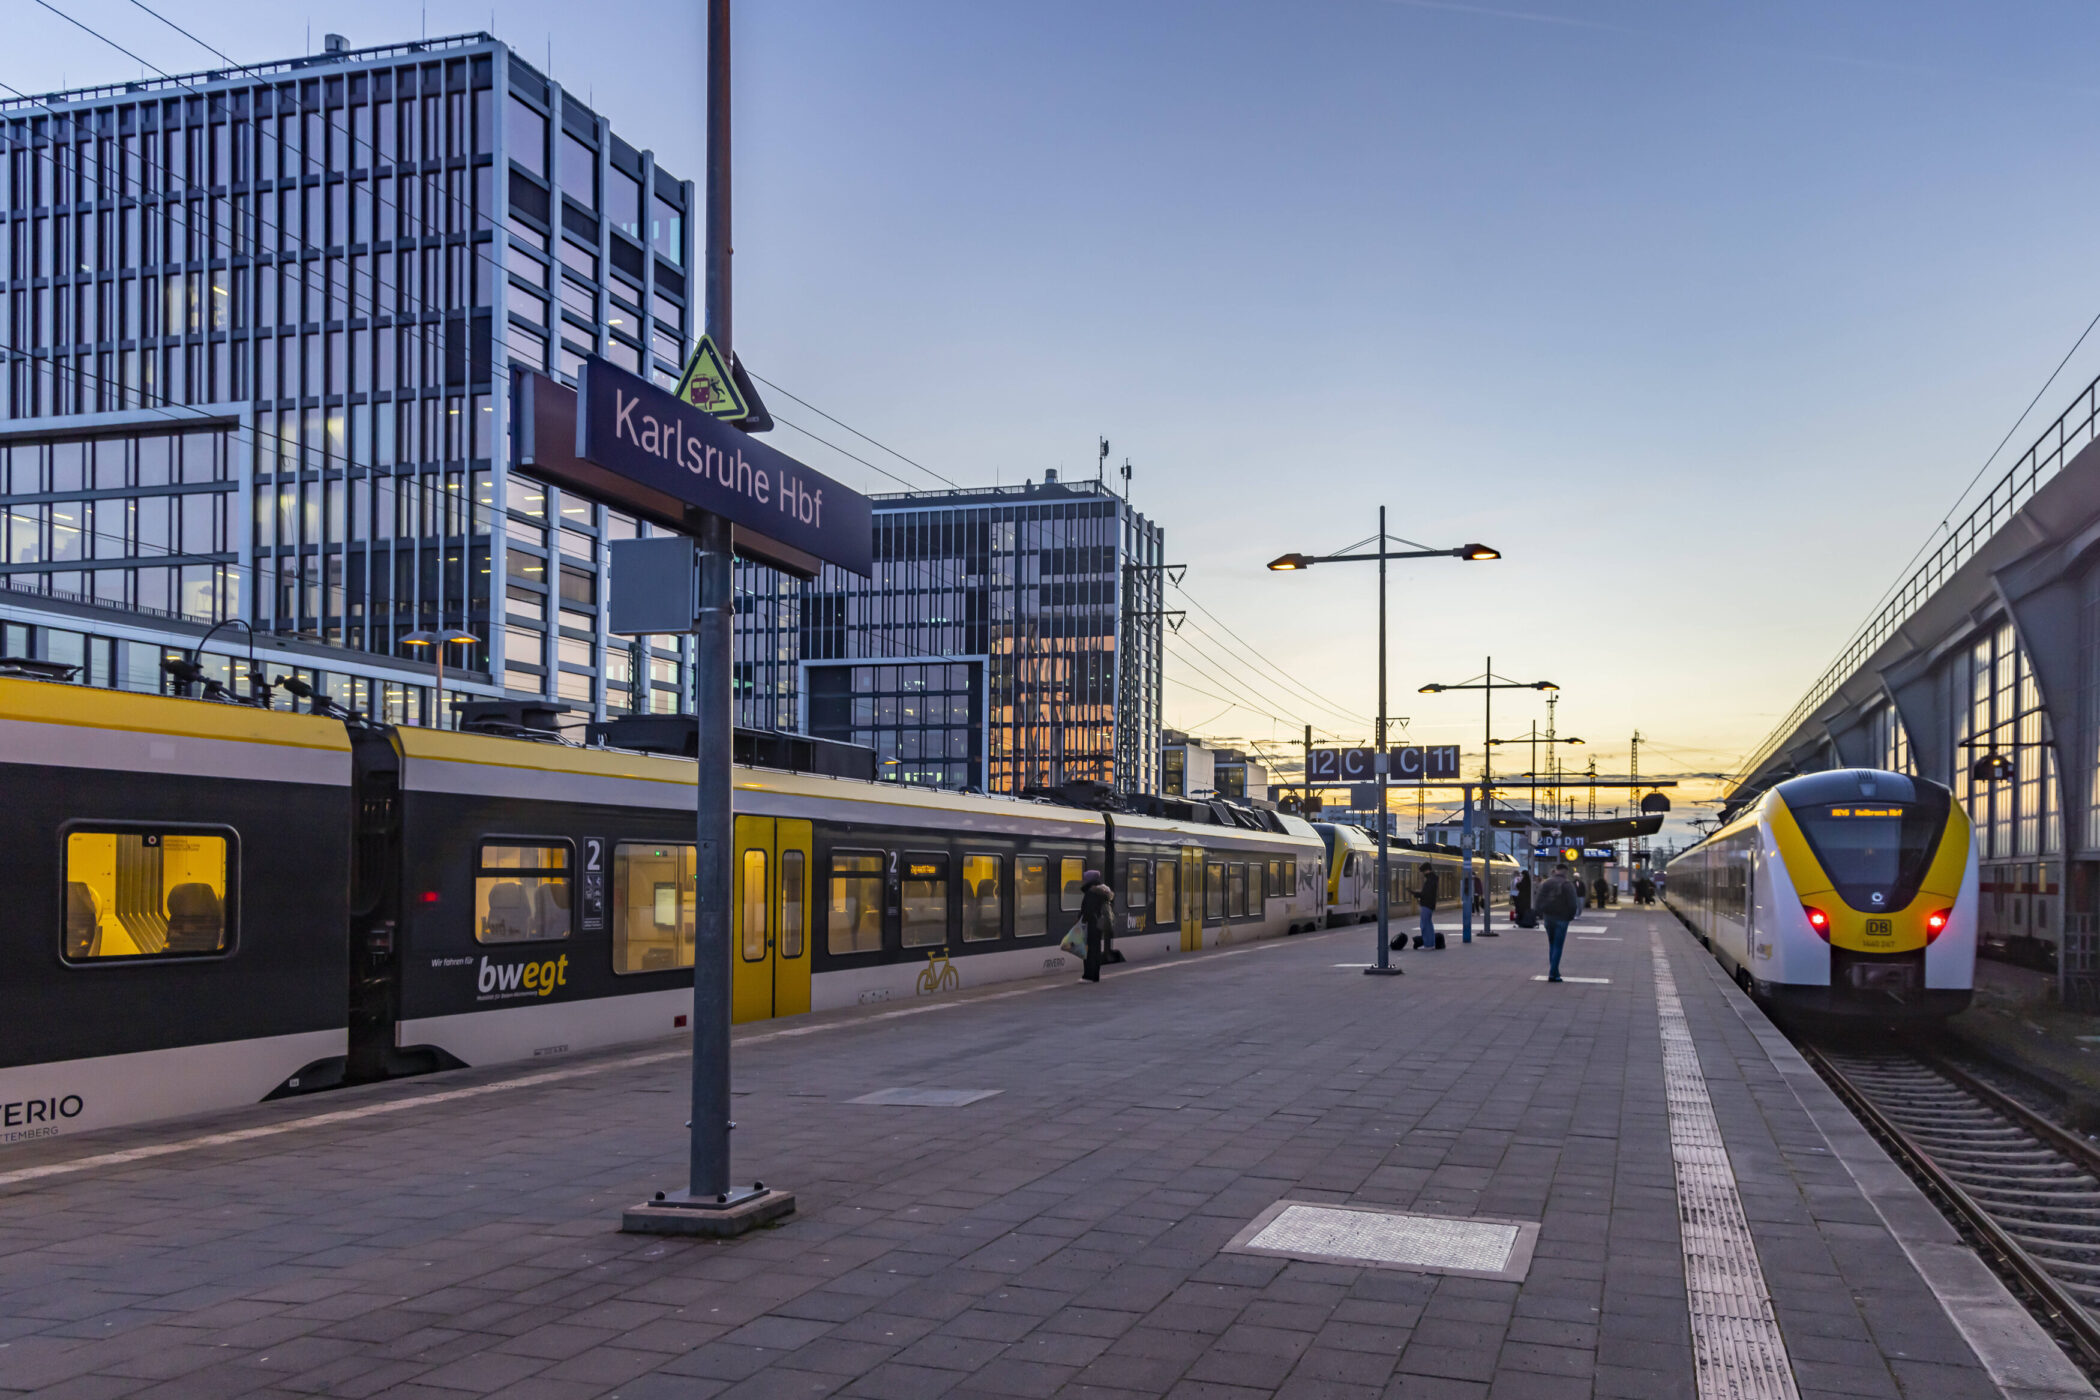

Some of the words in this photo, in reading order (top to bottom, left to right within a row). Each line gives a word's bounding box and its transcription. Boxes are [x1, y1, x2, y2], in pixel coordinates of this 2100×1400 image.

[616, 388, 770, 504] Karlsruhe
[779, 470, 823, 529] Hbf
[1307, 750, 1335, 774] 12
[1345, 748, 1365, 774] C
[1400, 747, 1420, 773] C
[1432, 747, 1456, 772] 11
[1546, 836, 1554, 847] D
[1564, 836, 1572, 847] D
[1576, 836, 1585, 847] 11
[587, 839, 601, 871] 2
[889, 851, 897, 873] 2
[1127, 912, 1147, 932] bwegt
[1869, 920, 1889, 934] DB
[478, 953, 569, 997] bwegt
[0, 1094, 84, 1127] ERIO
